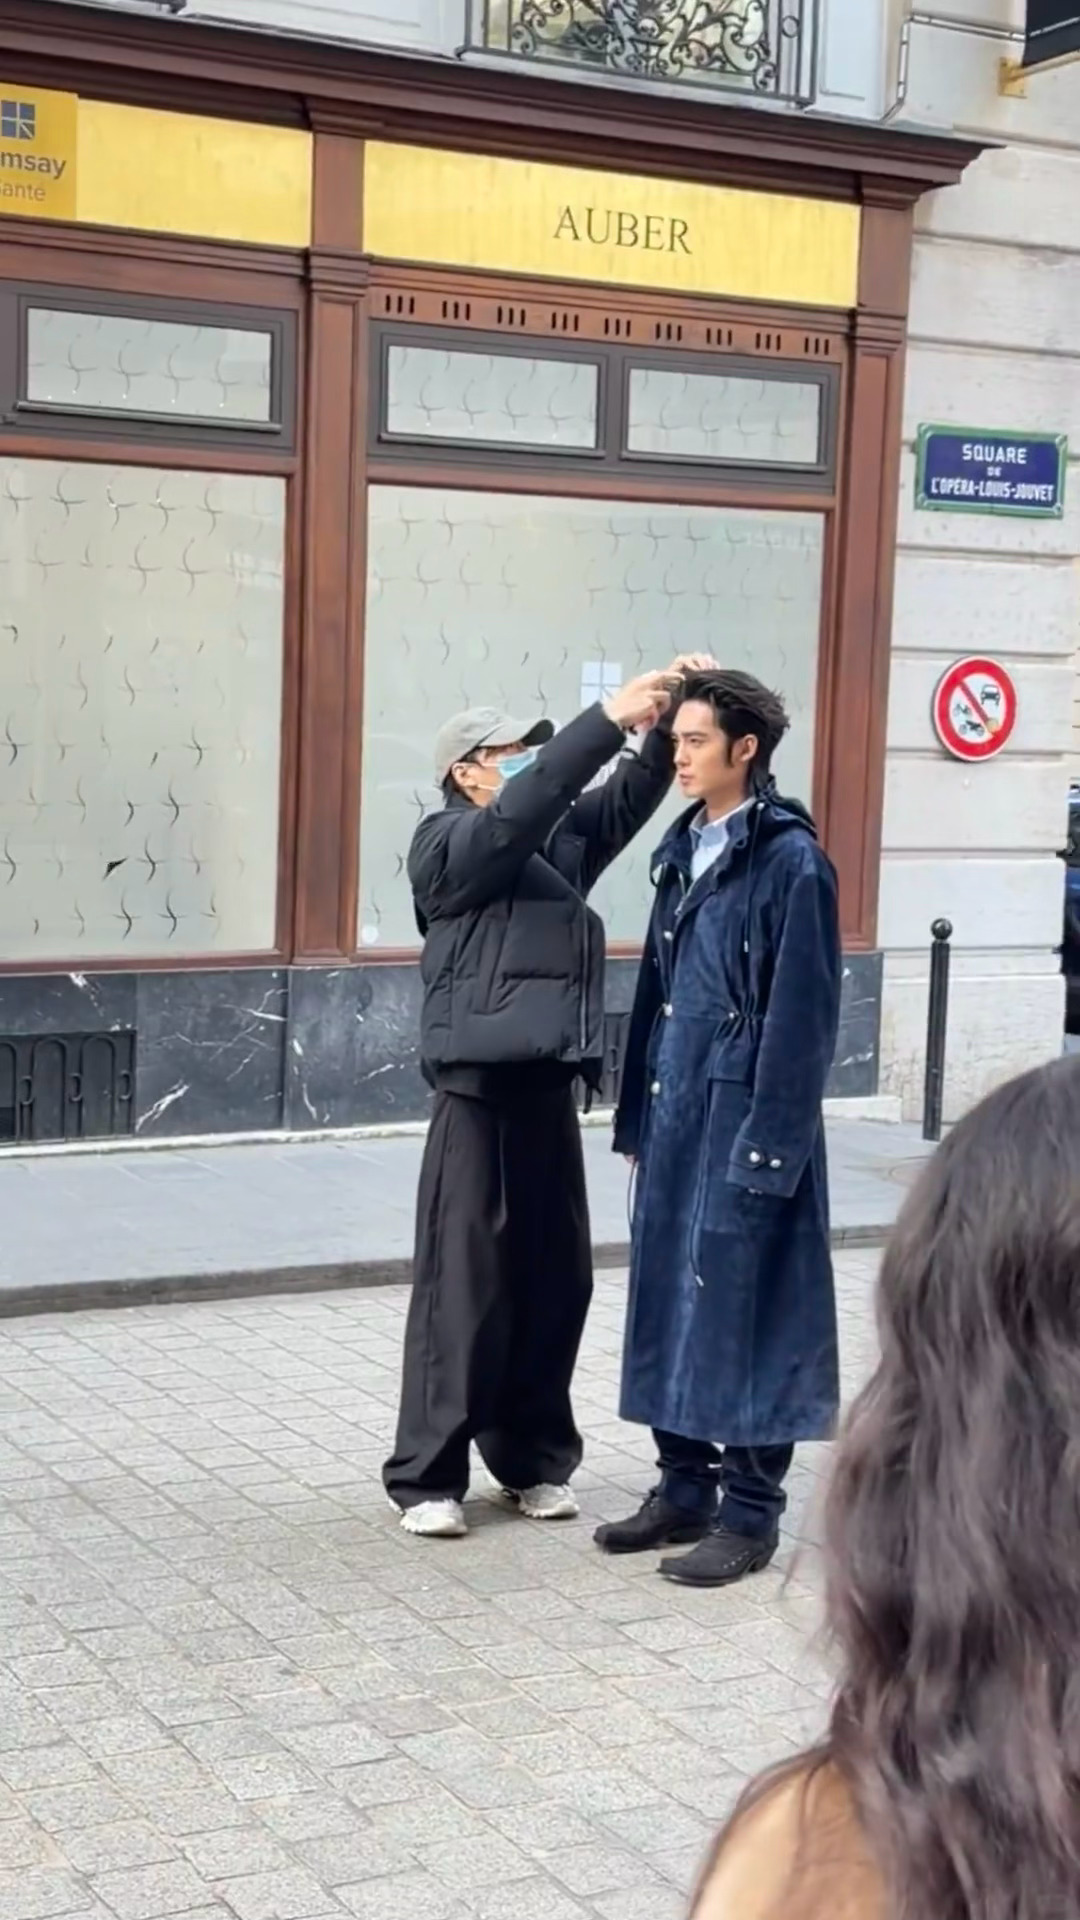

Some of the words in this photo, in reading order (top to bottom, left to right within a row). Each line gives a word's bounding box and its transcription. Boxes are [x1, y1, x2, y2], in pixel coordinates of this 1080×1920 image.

[553, 205, 692, 254] AUBER
[962, 444, 1027, 464] SQUARE
[987, 466, 1001, 476] DE
